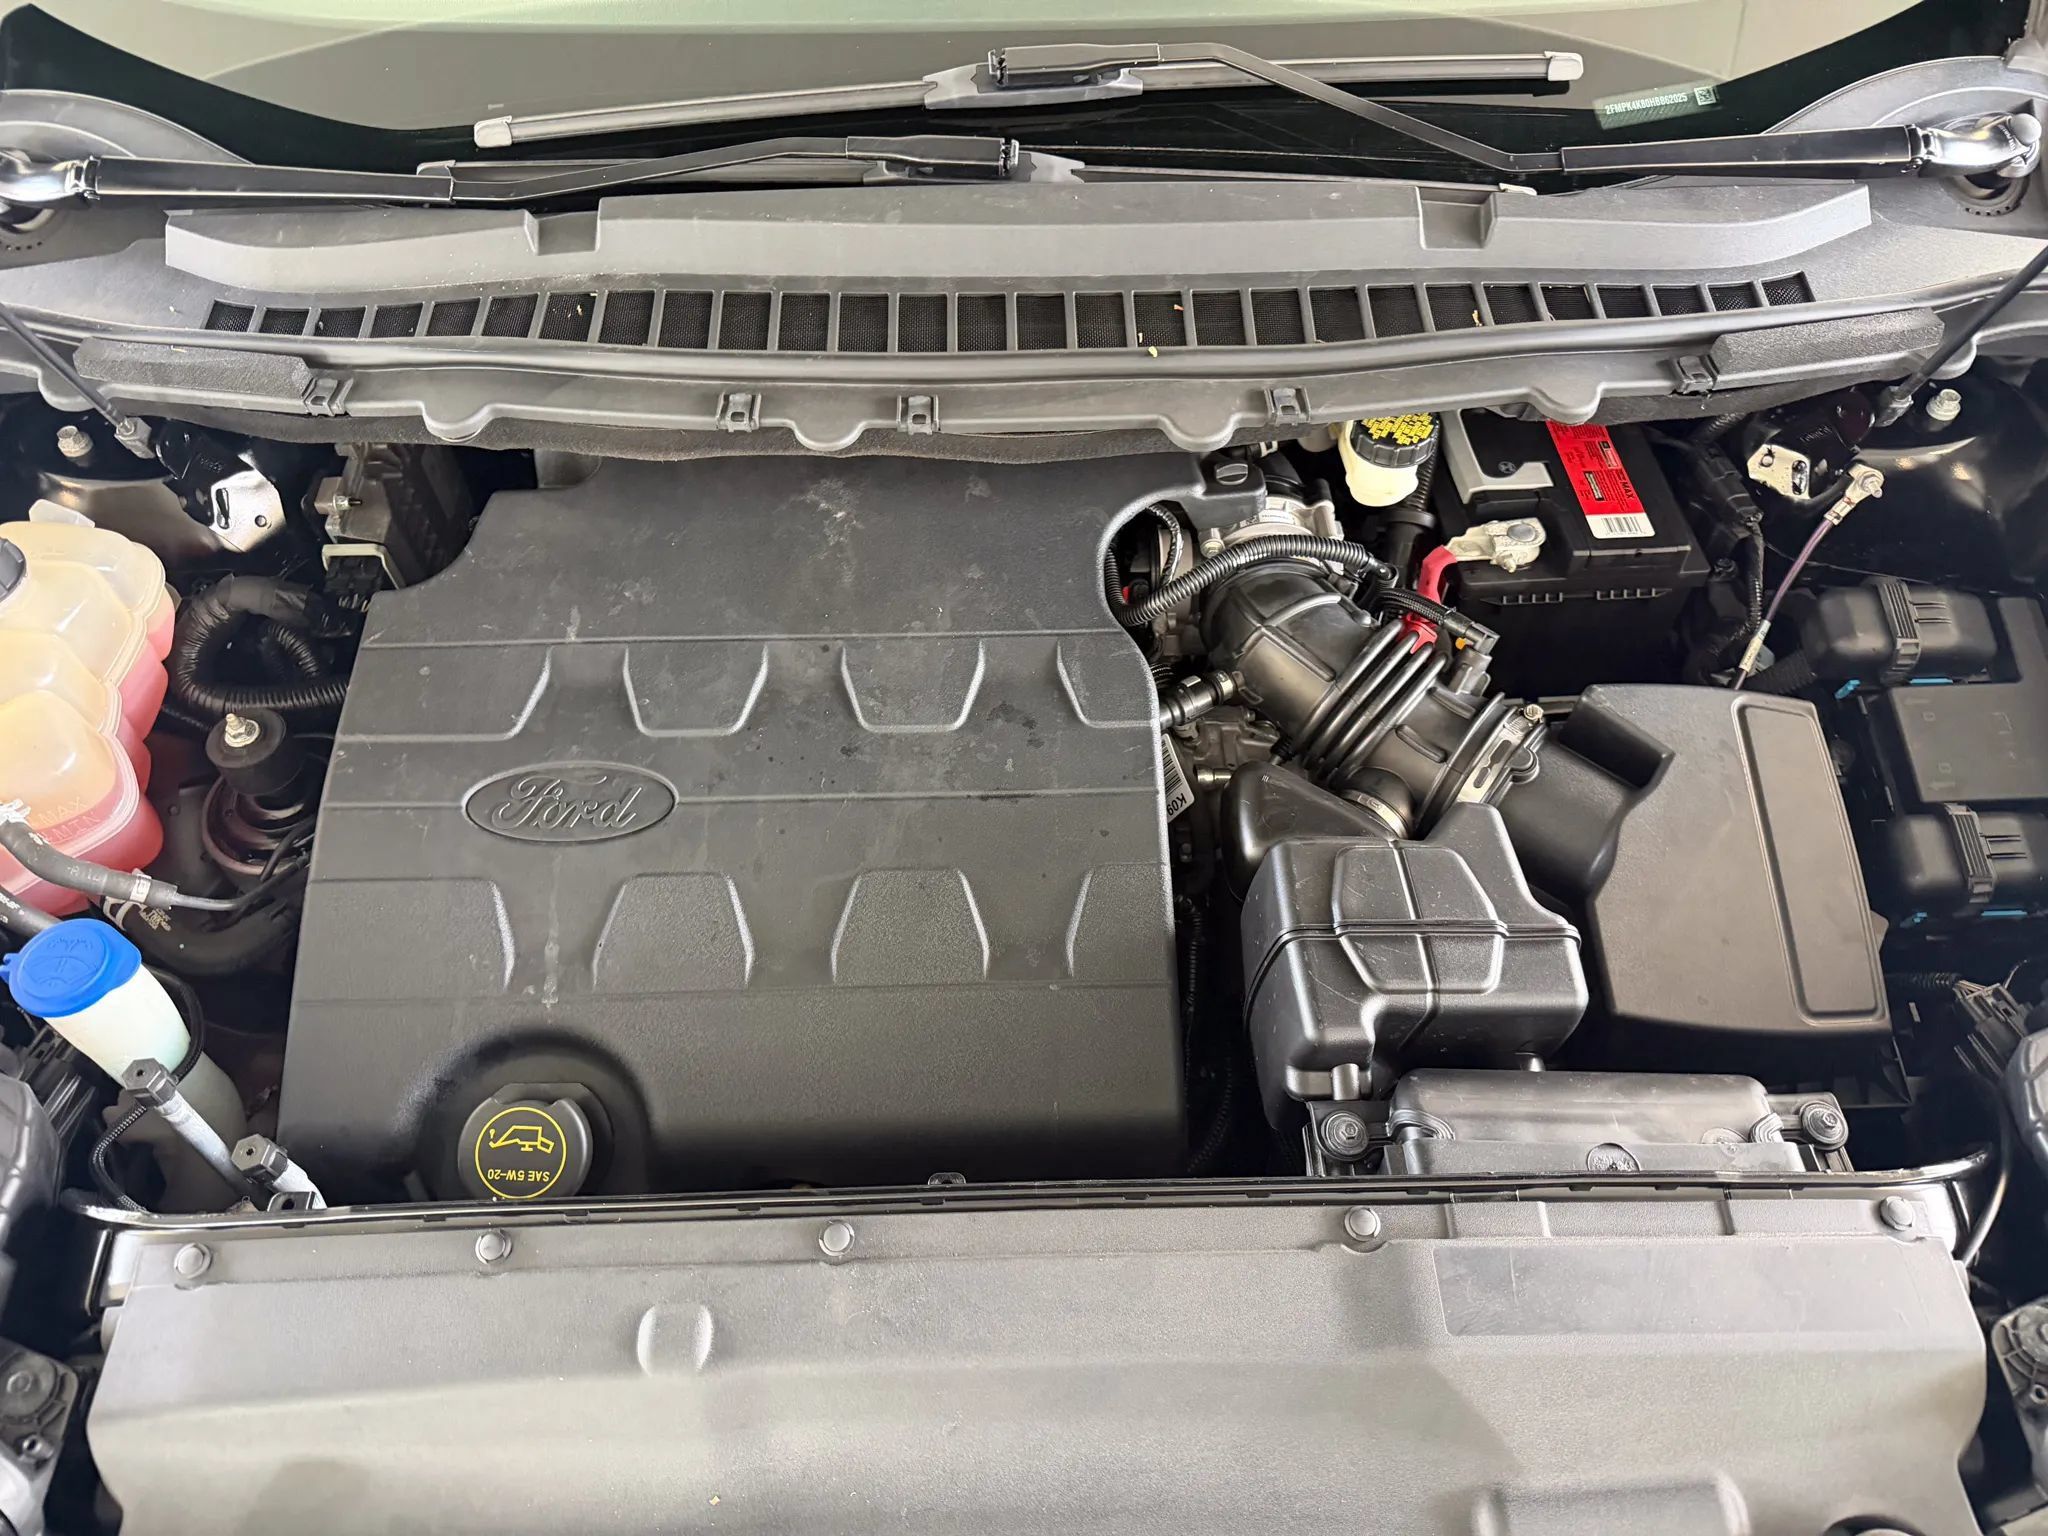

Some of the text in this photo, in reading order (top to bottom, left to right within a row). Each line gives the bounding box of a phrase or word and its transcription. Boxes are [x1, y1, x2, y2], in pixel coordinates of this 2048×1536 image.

[491, 774, 644, 830] Ford
[487, 1168, 550, 1182] SAE 5W-20
